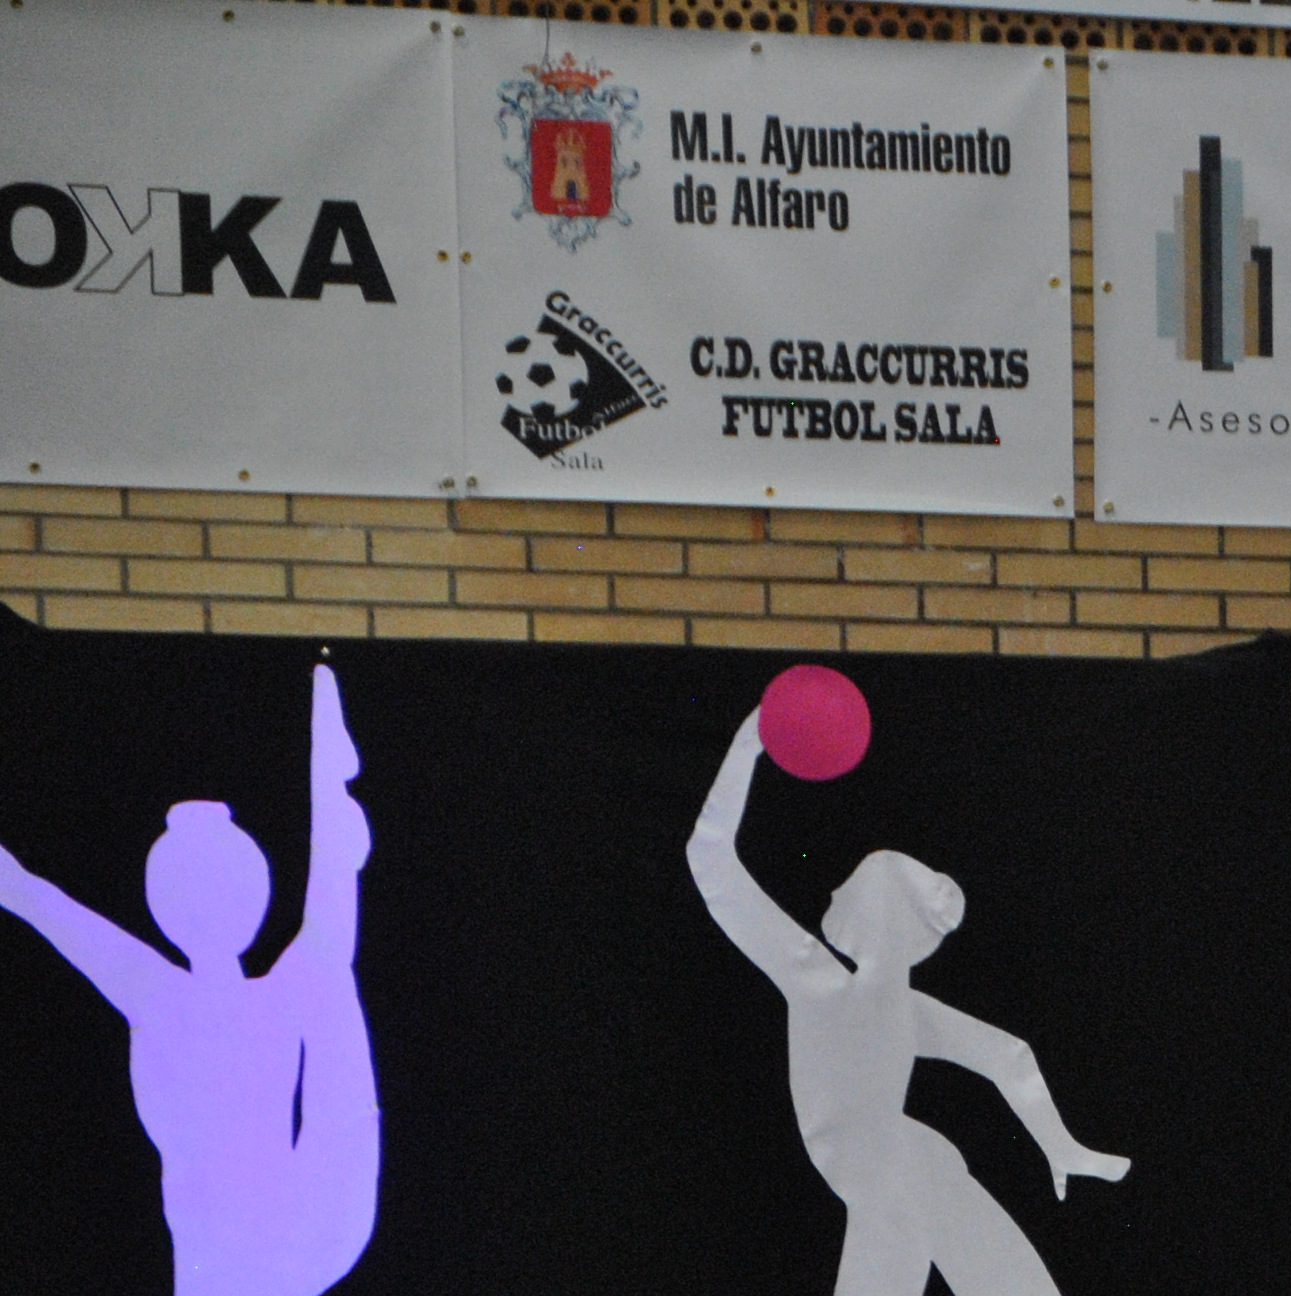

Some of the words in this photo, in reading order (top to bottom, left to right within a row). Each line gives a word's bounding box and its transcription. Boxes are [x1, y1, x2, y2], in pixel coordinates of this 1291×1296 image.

[670, 109, 745, 164] M.I.
[761, 116, 1012, 176] Ayuntamiento
[673, 174, 718, 225] de
[731, 176, 850, 231] Alfaro
[545, 289, 669, 409] Graccurris
[690, 337, 760, 379] C.D.
[769, 340, 1030, 390] GRACCURRIS
[721, 395, 887, 442] FUTBOL
[894, 403, 1000, 446] SALA
[551, 449, 604, 471] Sala
